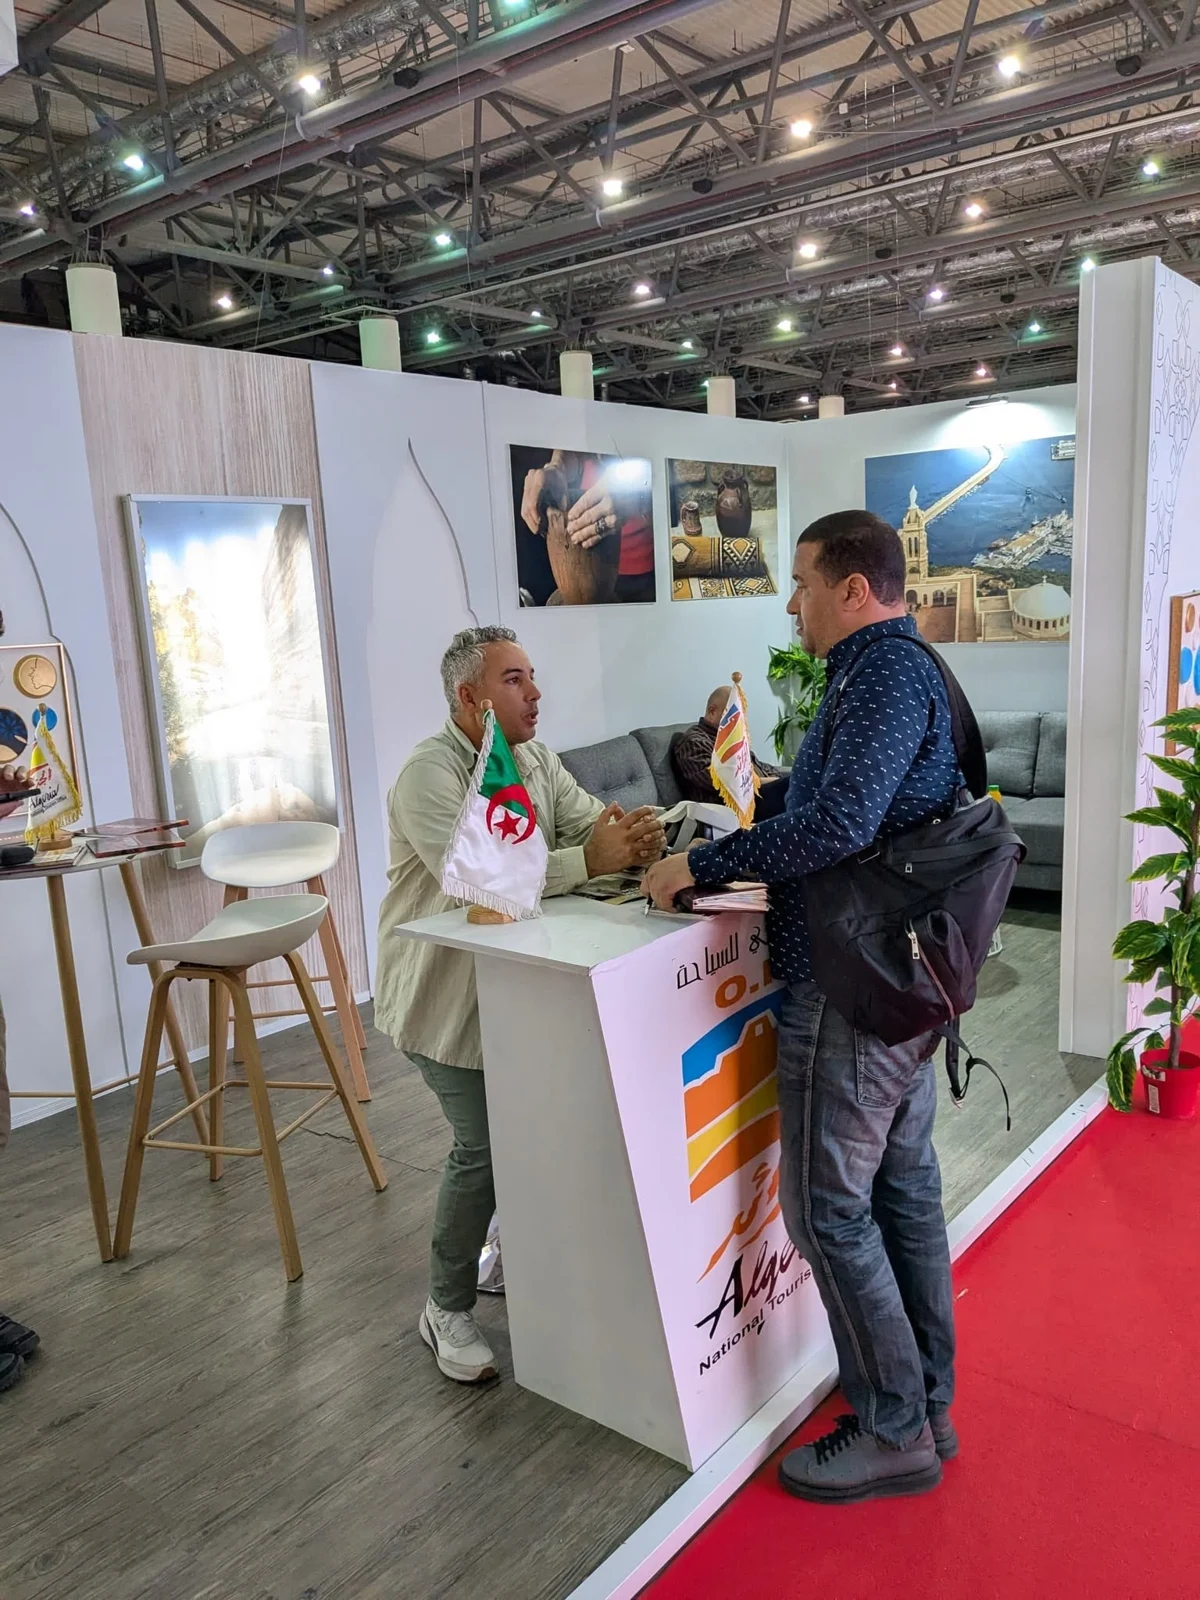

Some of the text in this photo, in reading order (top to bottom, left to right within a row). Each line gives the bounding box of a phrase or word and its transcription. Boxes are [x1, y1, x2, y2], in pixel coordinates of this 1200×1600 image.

[676, 931, 740, 990] للسياحة
[699, 1268, 812, 1376] National Touris
